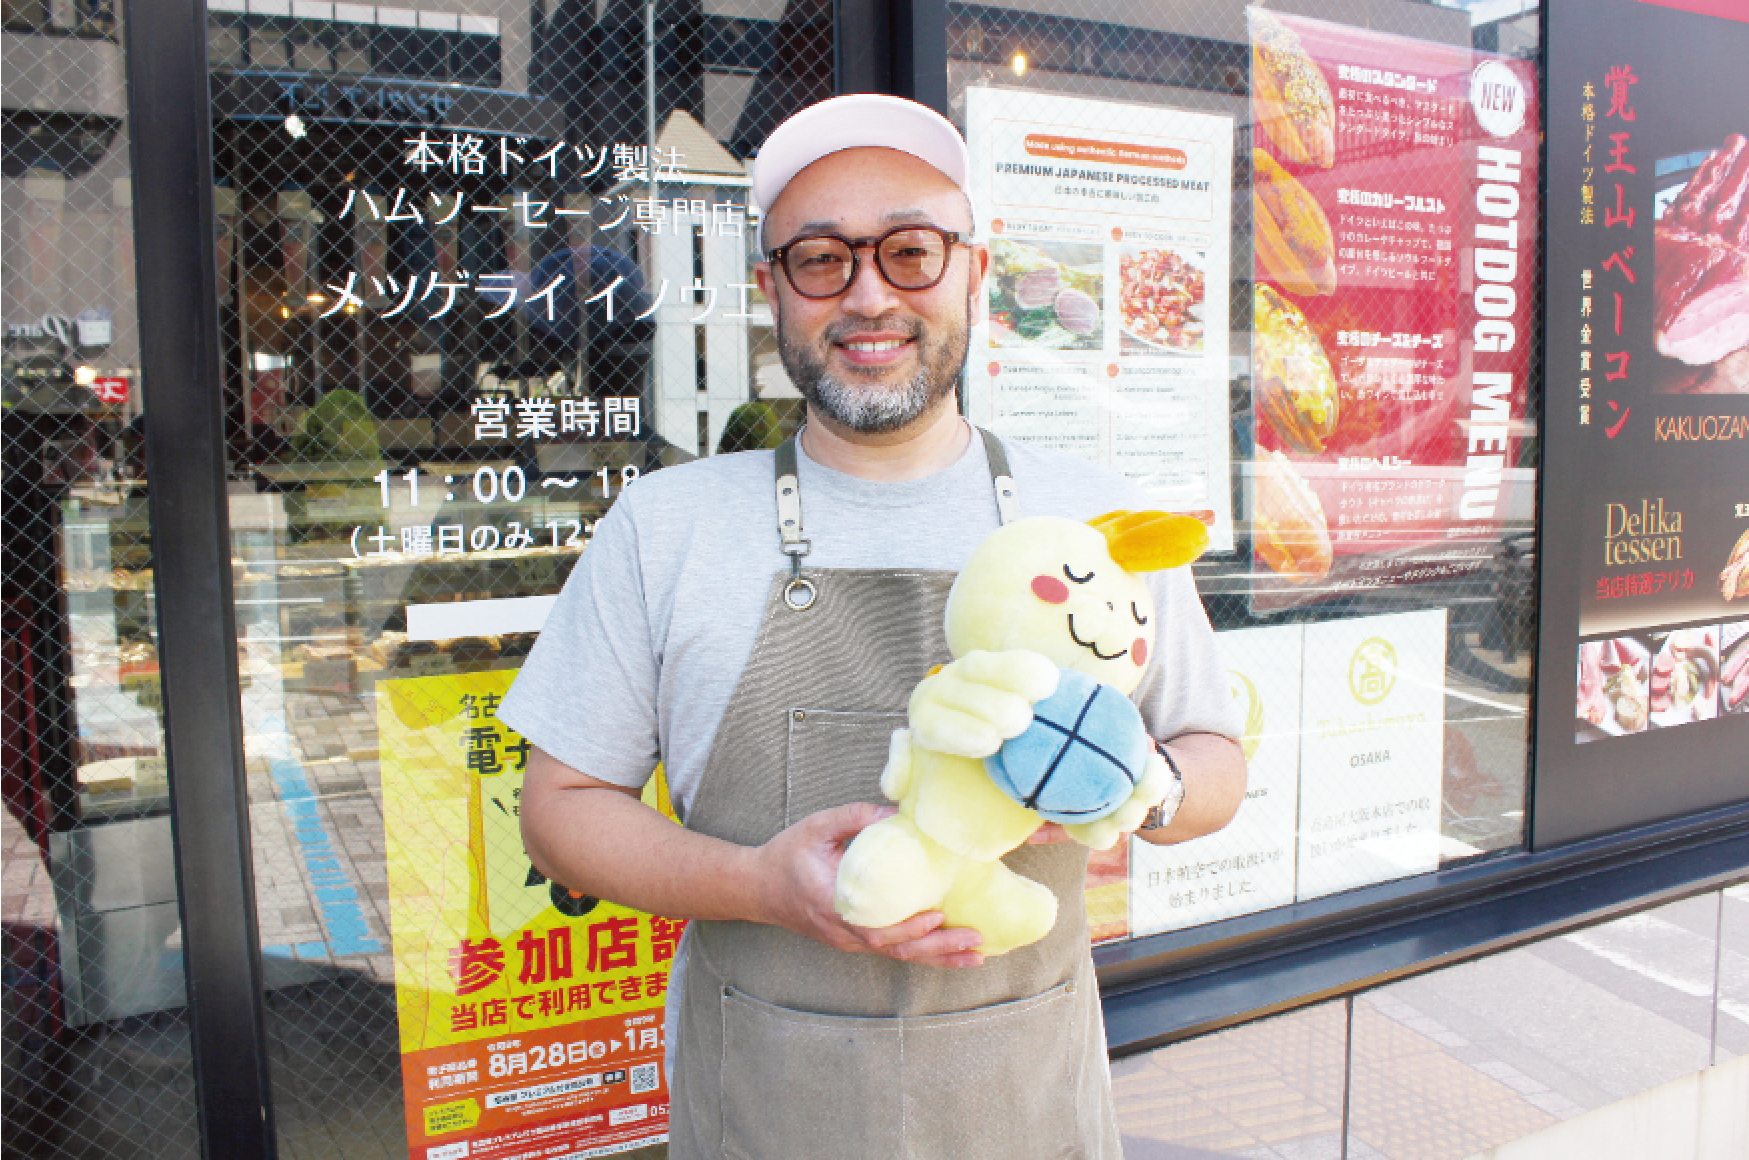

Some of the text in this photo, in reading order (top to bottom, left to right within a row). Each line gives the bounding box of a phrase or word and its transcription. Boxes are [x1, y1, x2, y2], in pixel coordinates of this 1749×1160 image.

[1480, 82, 1518, 113] NEW
[403, 132, 688, 183] 本格ドイツ製法
[1582, 81, 1596, 225] 本格ドイツ製法
[996, 162, 1210, 192] PREMIUM JAPANESE PROCESSED MEAT
[339, 187, 743, 237] ハムソーセージ専門店
[1474, 145, 1522, 353] HOTDOG
[1601, 63, 1640, 439] 覚王山ベーコン
[470, 397, 641, 440] 営業時間
[1458, 371, 1514, 521] MENU
[1604, 498, 1683, 539] Delika
[1604, 534, 1683, 566] tessen
[1597, 568, 1695, 600] 当店特選デリカ
[1316, 709, 1427, 740] Takashimaya
[1350, 750, 1391, 768] OSAKA
[651, 1103, 669, 1117] 05
